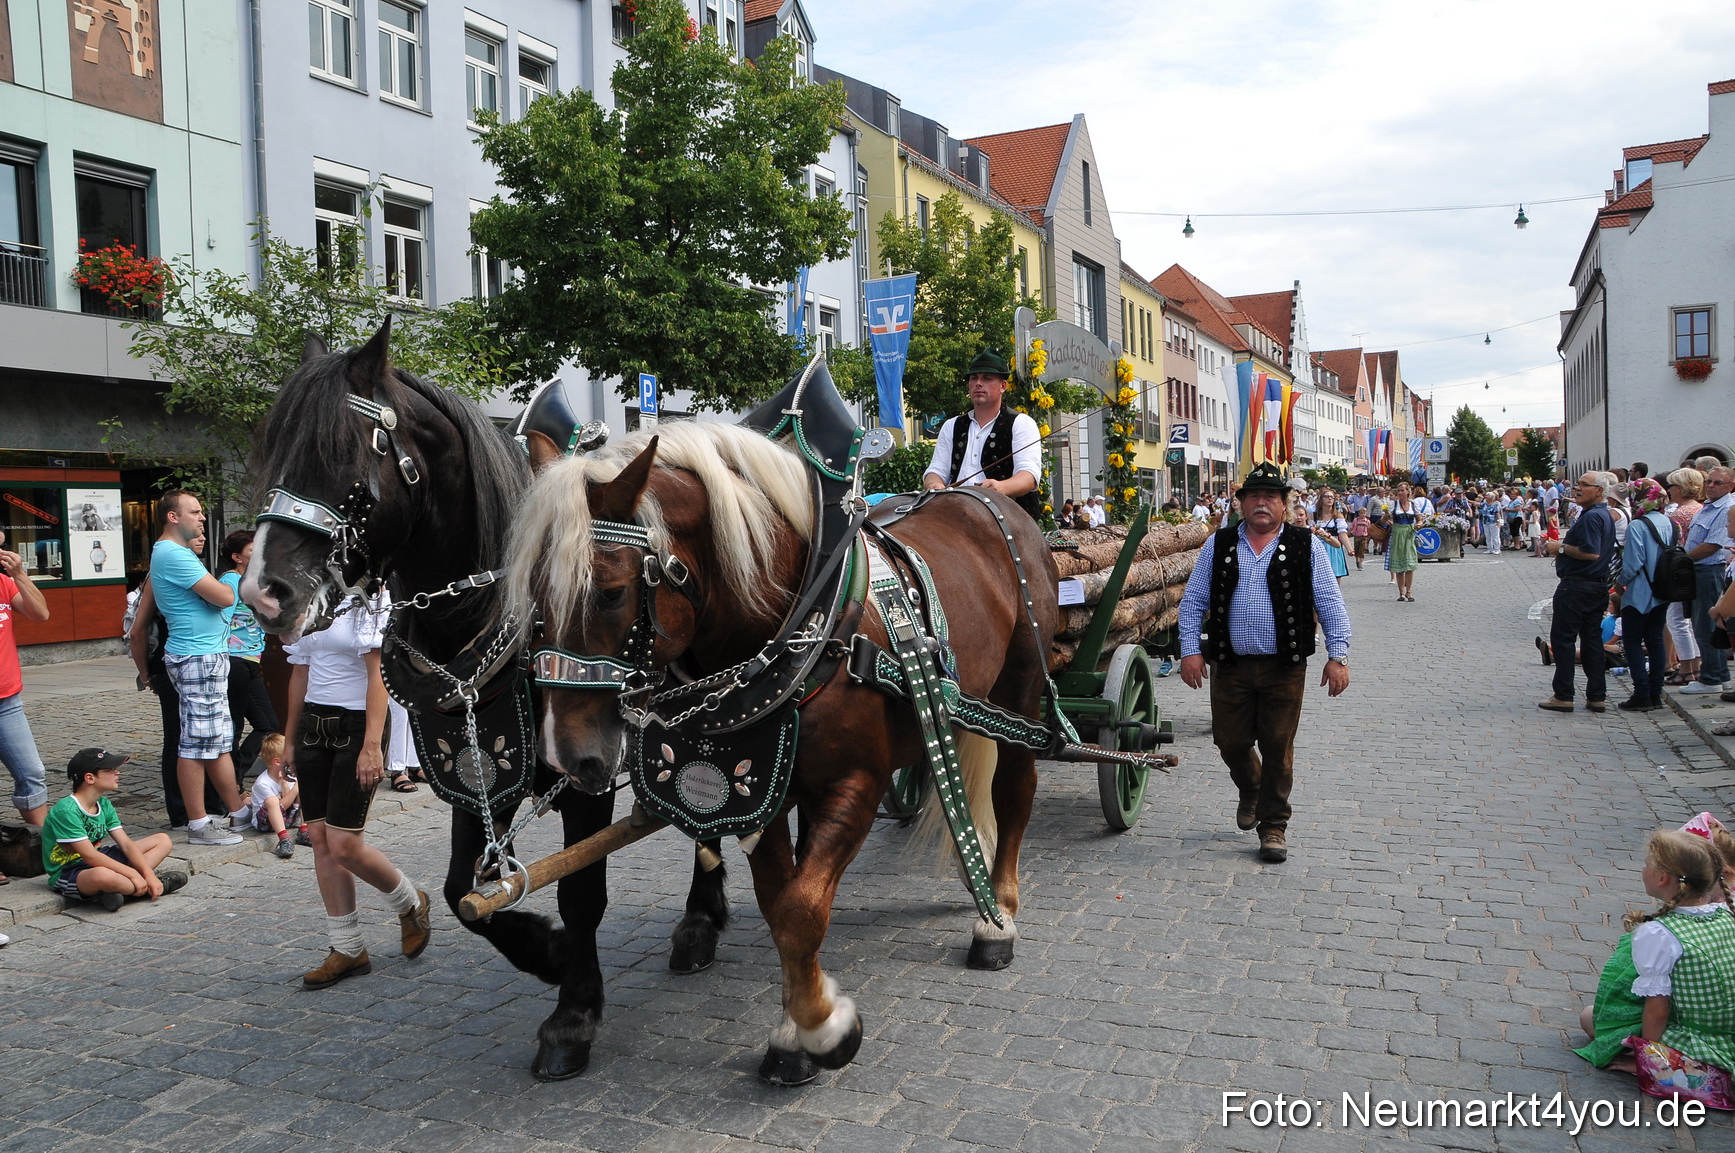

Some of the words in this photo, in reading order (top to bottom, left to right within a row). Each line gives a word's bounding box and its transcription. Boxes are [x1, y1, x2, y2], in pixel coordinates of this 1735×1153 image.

[643, 379, 653, 408] P
[685, 773, 722, 789] Holzrückerei
[685, 785, 718, 800] Weismann
